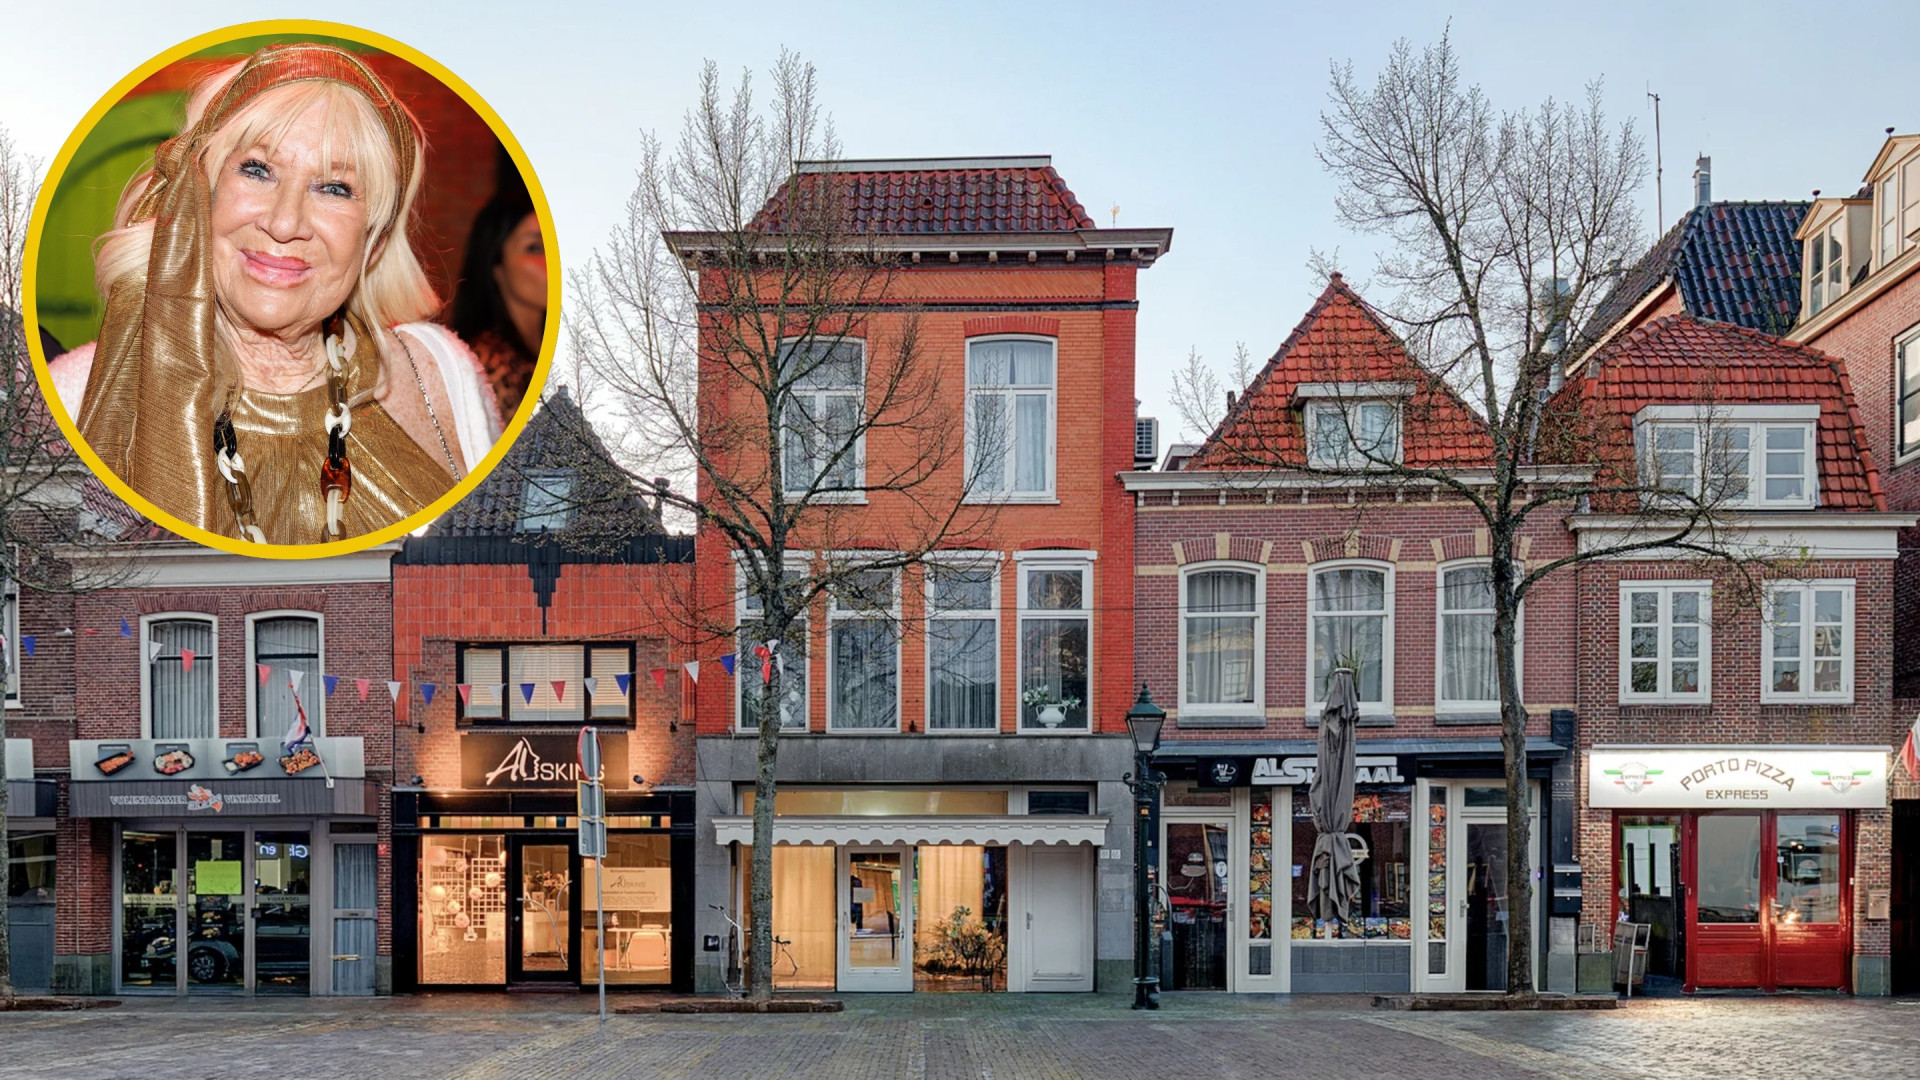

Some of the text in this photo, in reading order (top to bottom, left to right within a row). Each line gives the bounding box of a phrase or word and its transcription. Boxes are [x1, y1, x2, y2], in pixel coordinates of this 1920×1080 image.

[1680, 758, 1795, 791] PORTO PIZZA
[110, 793, 281, 805] VOLENDAMMER VISHANDEL
[1705, 789, 1768, 800] EXPRESS
